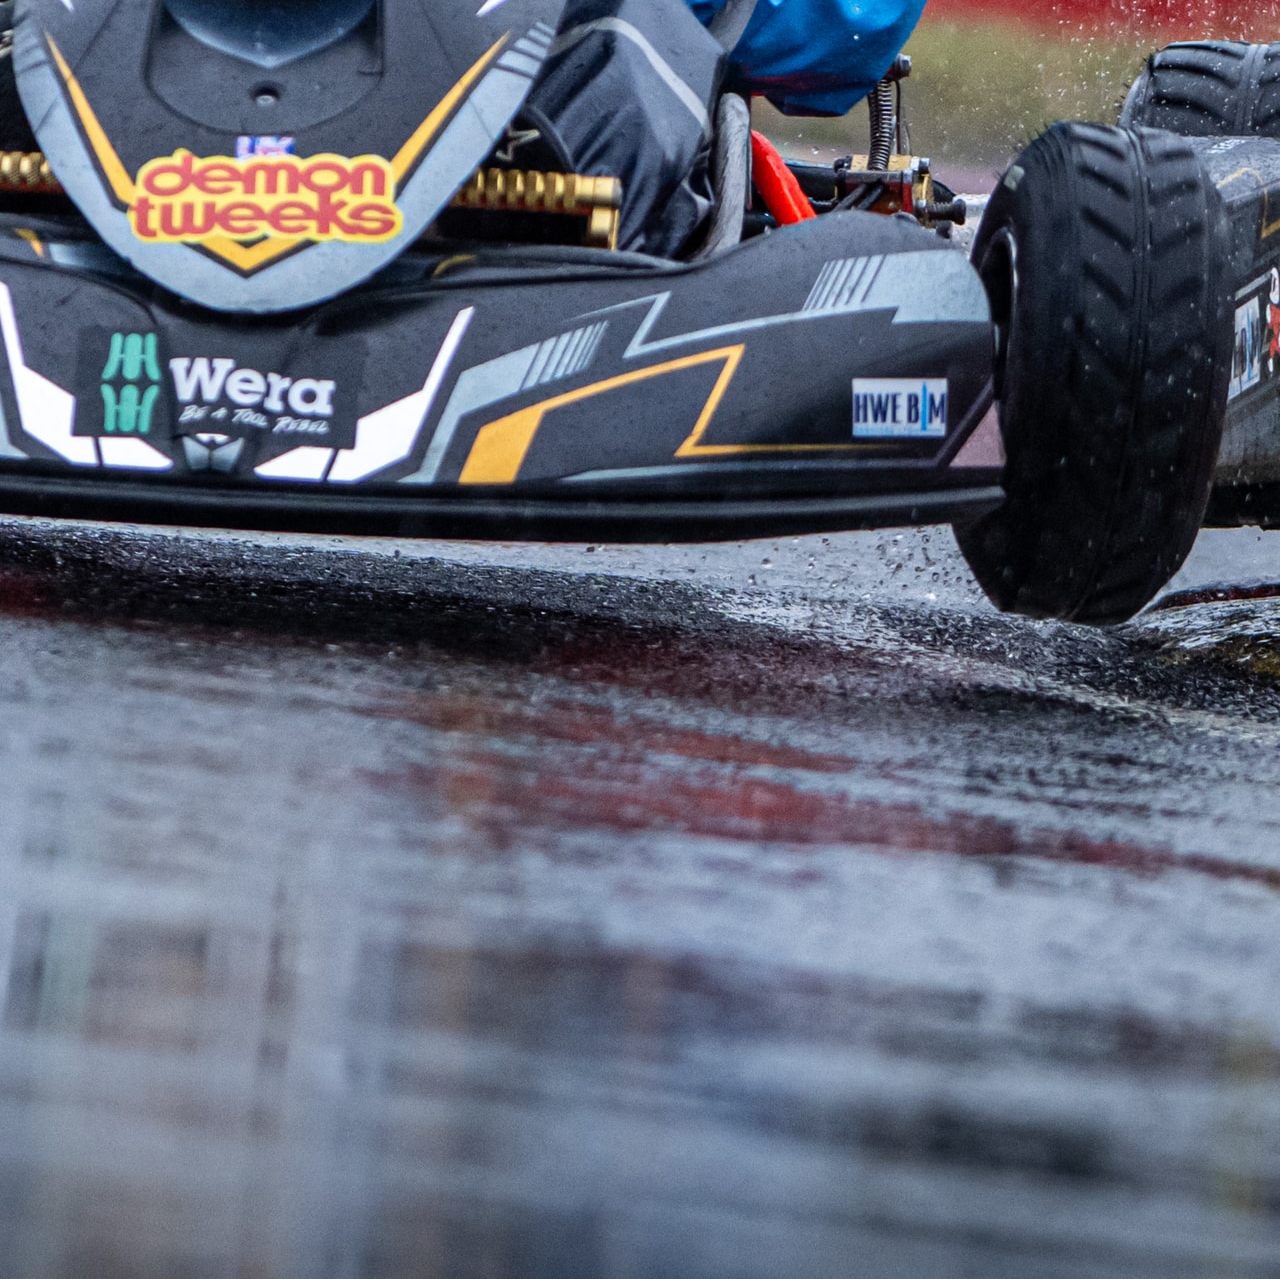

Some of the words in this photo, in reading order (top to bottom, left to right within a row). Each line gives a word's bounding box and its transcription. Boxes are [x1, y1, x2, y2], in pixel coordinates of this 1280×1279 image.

[142, 151, 387, 197] demon
[129, 194, 397, 238] tweeks
[169, 357, 337, 416] Wera
[853, 392, 902, 424] HWE
[179, 404, 210, 423] BE
[210, 407, 228, 419] A
[231, 408, 268, 429] TOOL
[271, 416, 330, 435] REBEL
